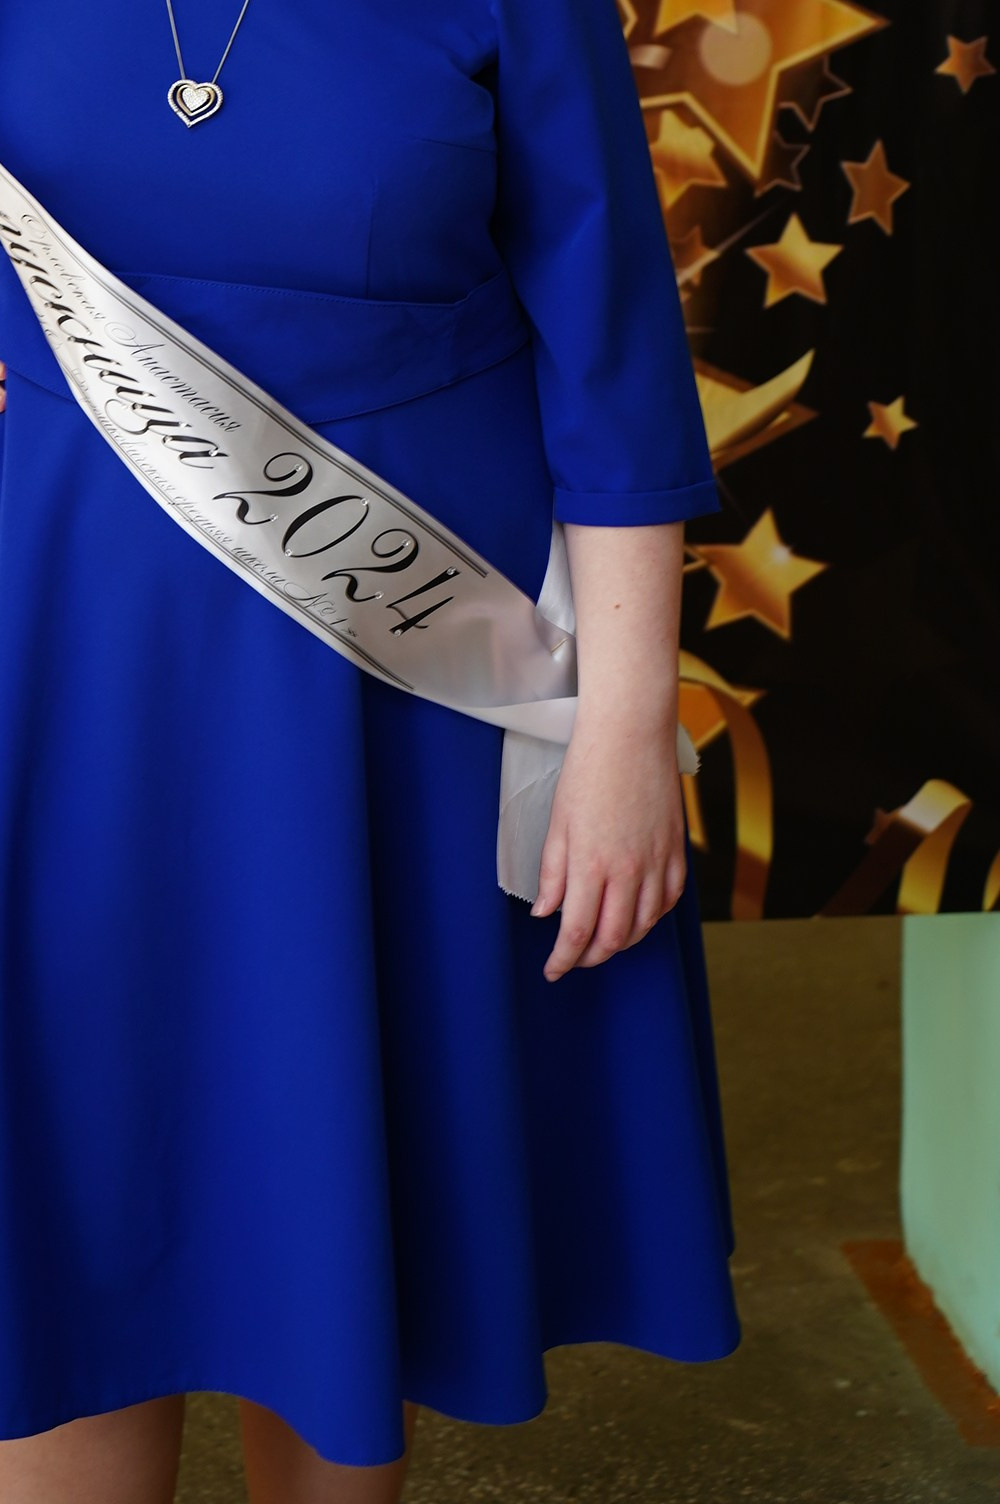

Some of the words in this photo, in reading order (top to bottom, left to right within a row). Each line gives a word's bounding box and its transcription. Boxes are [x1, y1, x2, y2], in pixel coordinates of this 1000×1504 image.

[104, 322, 244, 433] Анастасия
[212, 452, 464, 636] 2024
[230, 547, 286, 586] школа
